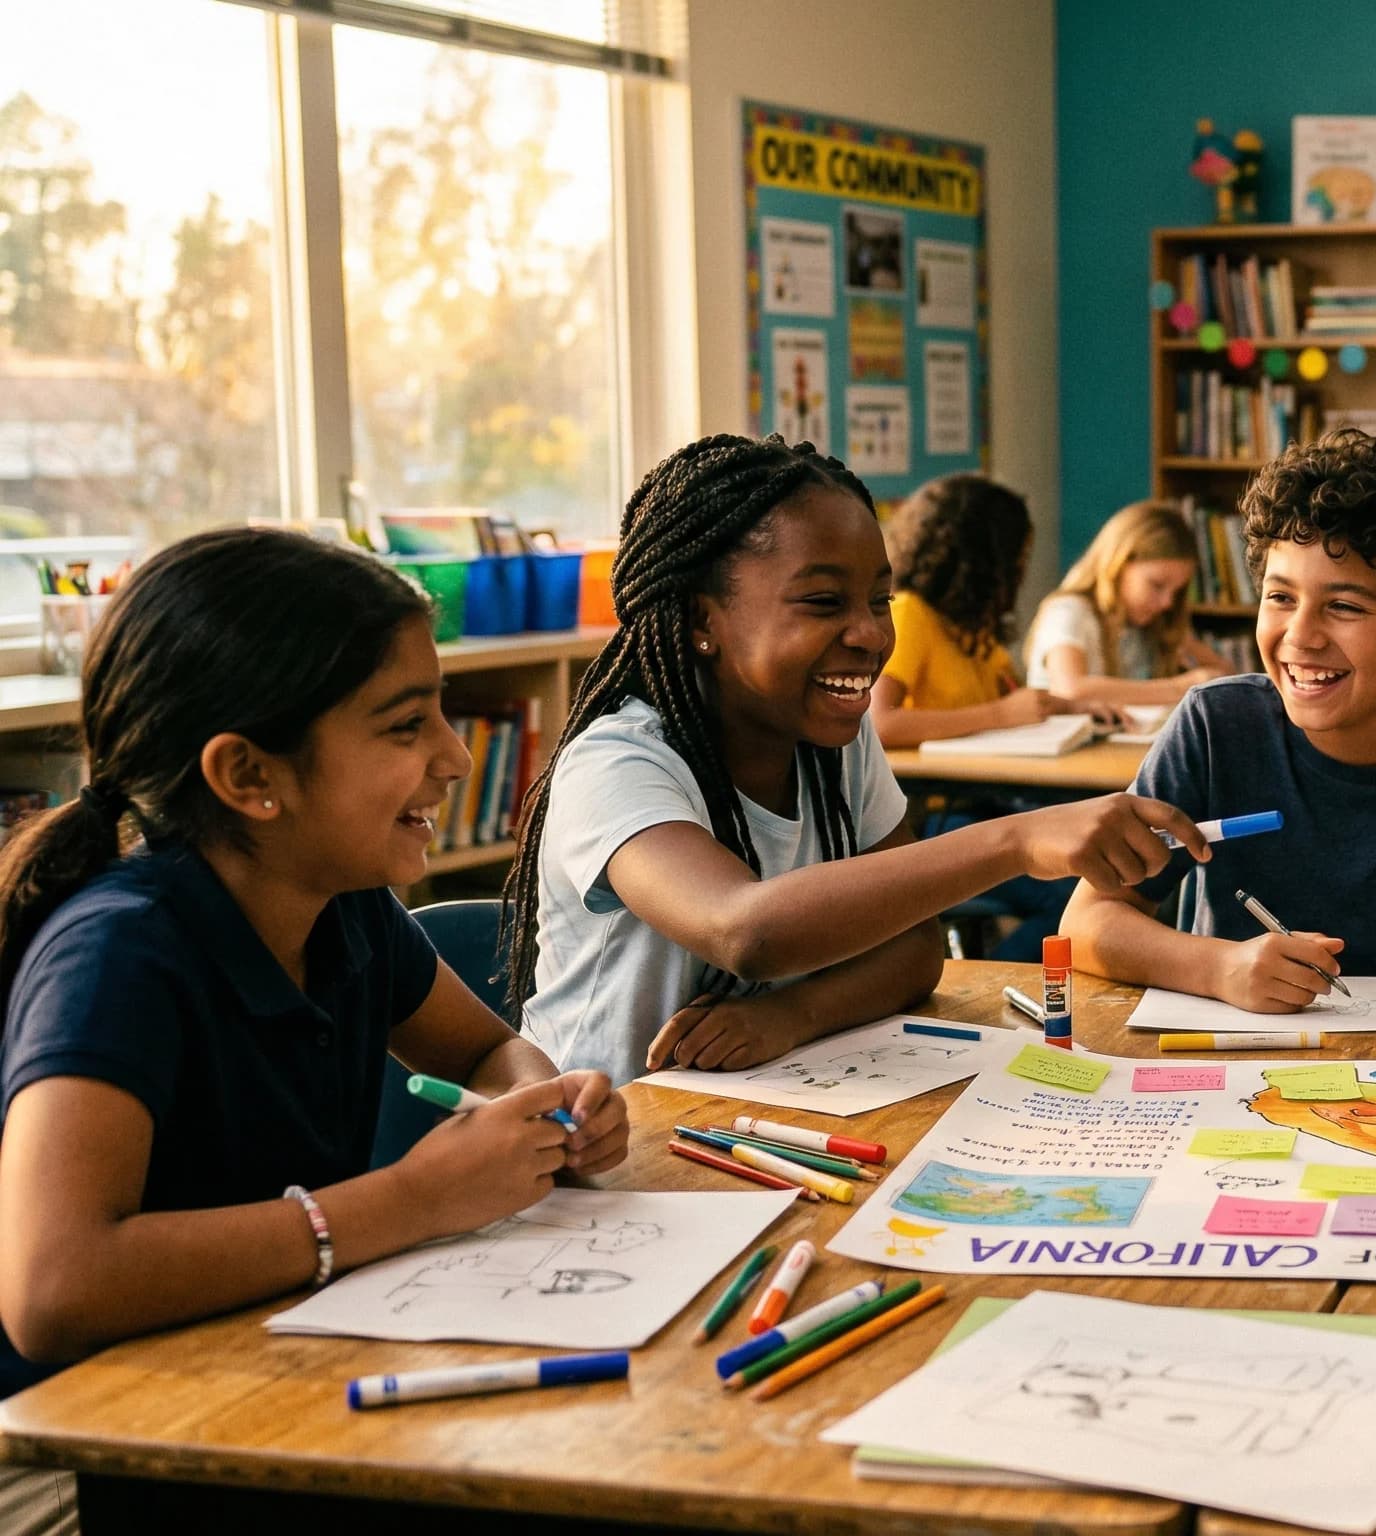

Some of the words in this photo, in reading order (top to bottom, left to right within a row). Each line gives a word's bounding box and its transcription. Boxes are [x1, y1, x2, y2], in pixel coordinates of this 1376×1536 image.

[762, 137, 818, 183] OUR
[827, 148, 973, 210] COMMUNITY
[970, 1237, 1319, 1268] CALIFORNIA
